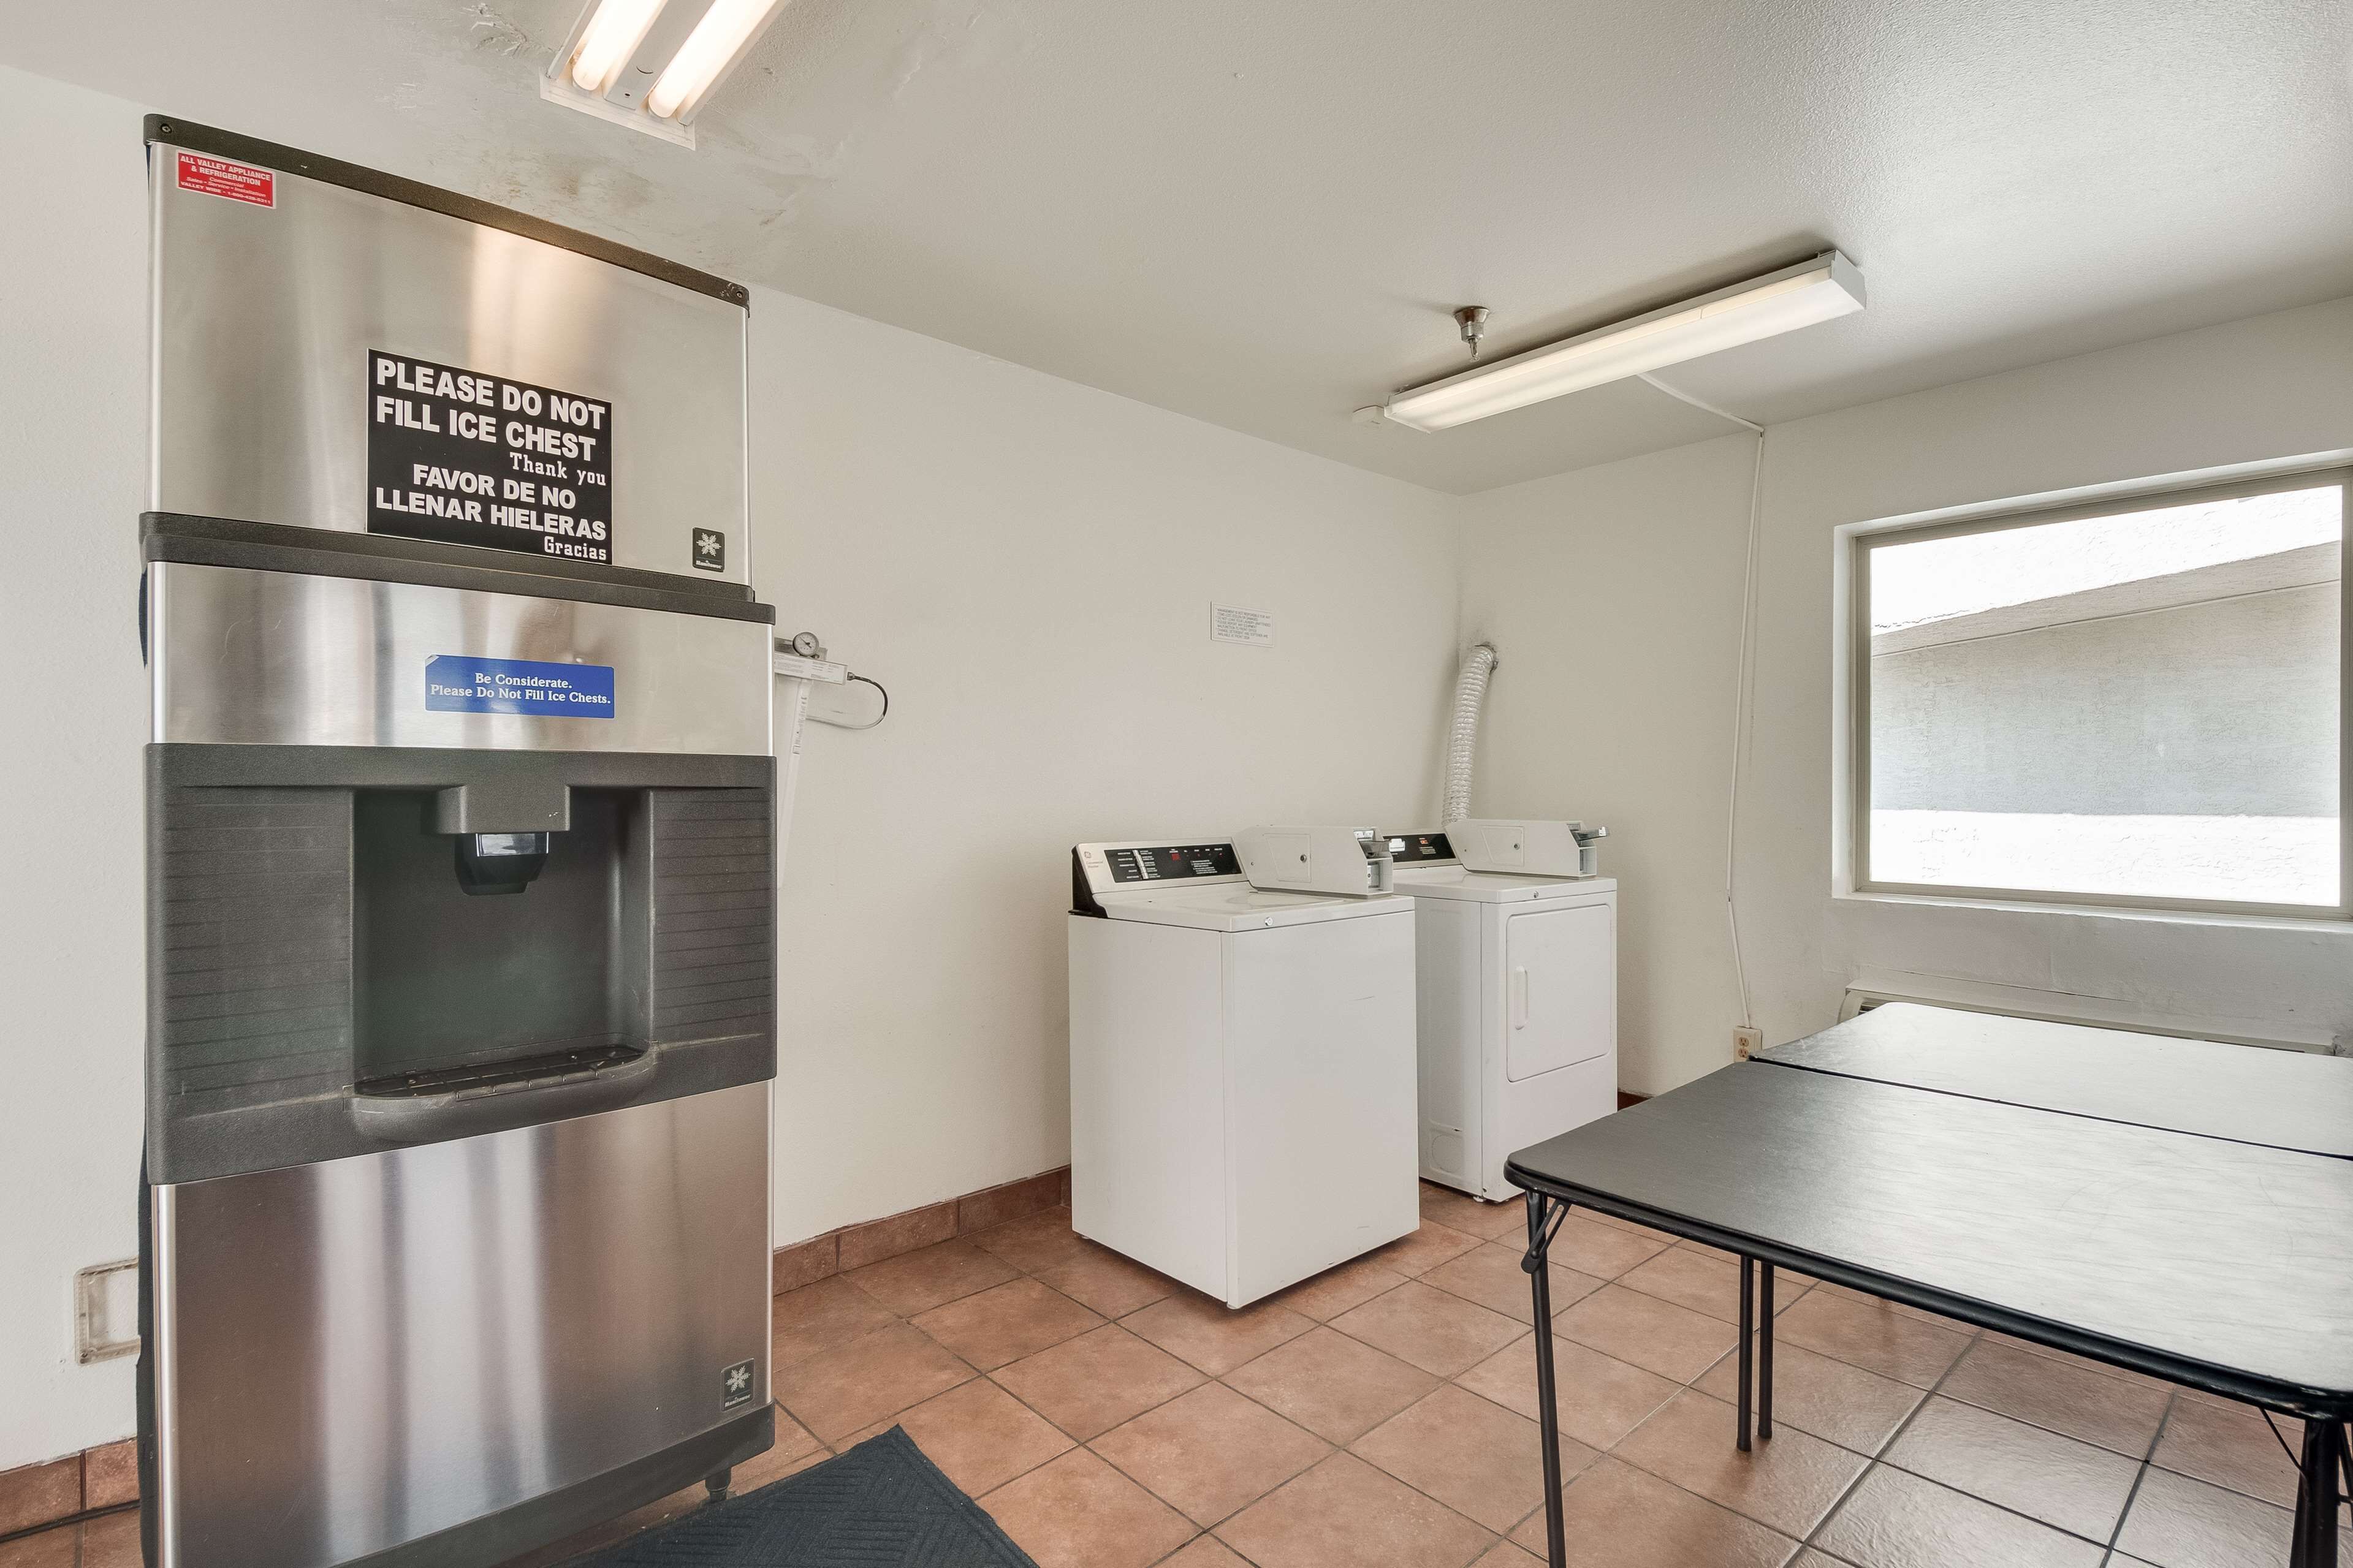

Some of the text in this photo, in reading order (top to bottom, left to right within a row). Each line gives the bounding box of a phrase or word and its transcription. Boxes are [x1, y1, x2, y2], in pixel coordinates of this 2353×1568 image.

[180, 156, 271, 181] ALL VALLEY APPLIANCE
[199, 167, 260, 186] REFRIGERATION
[180, 181, 205, 190] VALLEY
[208, 181, 230, 190] Service
[209, 176, 245, 188] Commercial
[377, 358, 606, 430] PLEASE DO NOT
[377, 395, 596, 461] FILL ICE CHEST
[509, 452, 606, 486] Thank you
[413, 463, 576, 509] FAVOR DE NO
[376, 487, 606, 540] LLENAR HIELERAS
[544, 536, 607, 561] Gracias
[475, 672, 572, 689] Be Considerate.
[430, 684, 611, 704] Please Do Not Fill Ice Chests.
